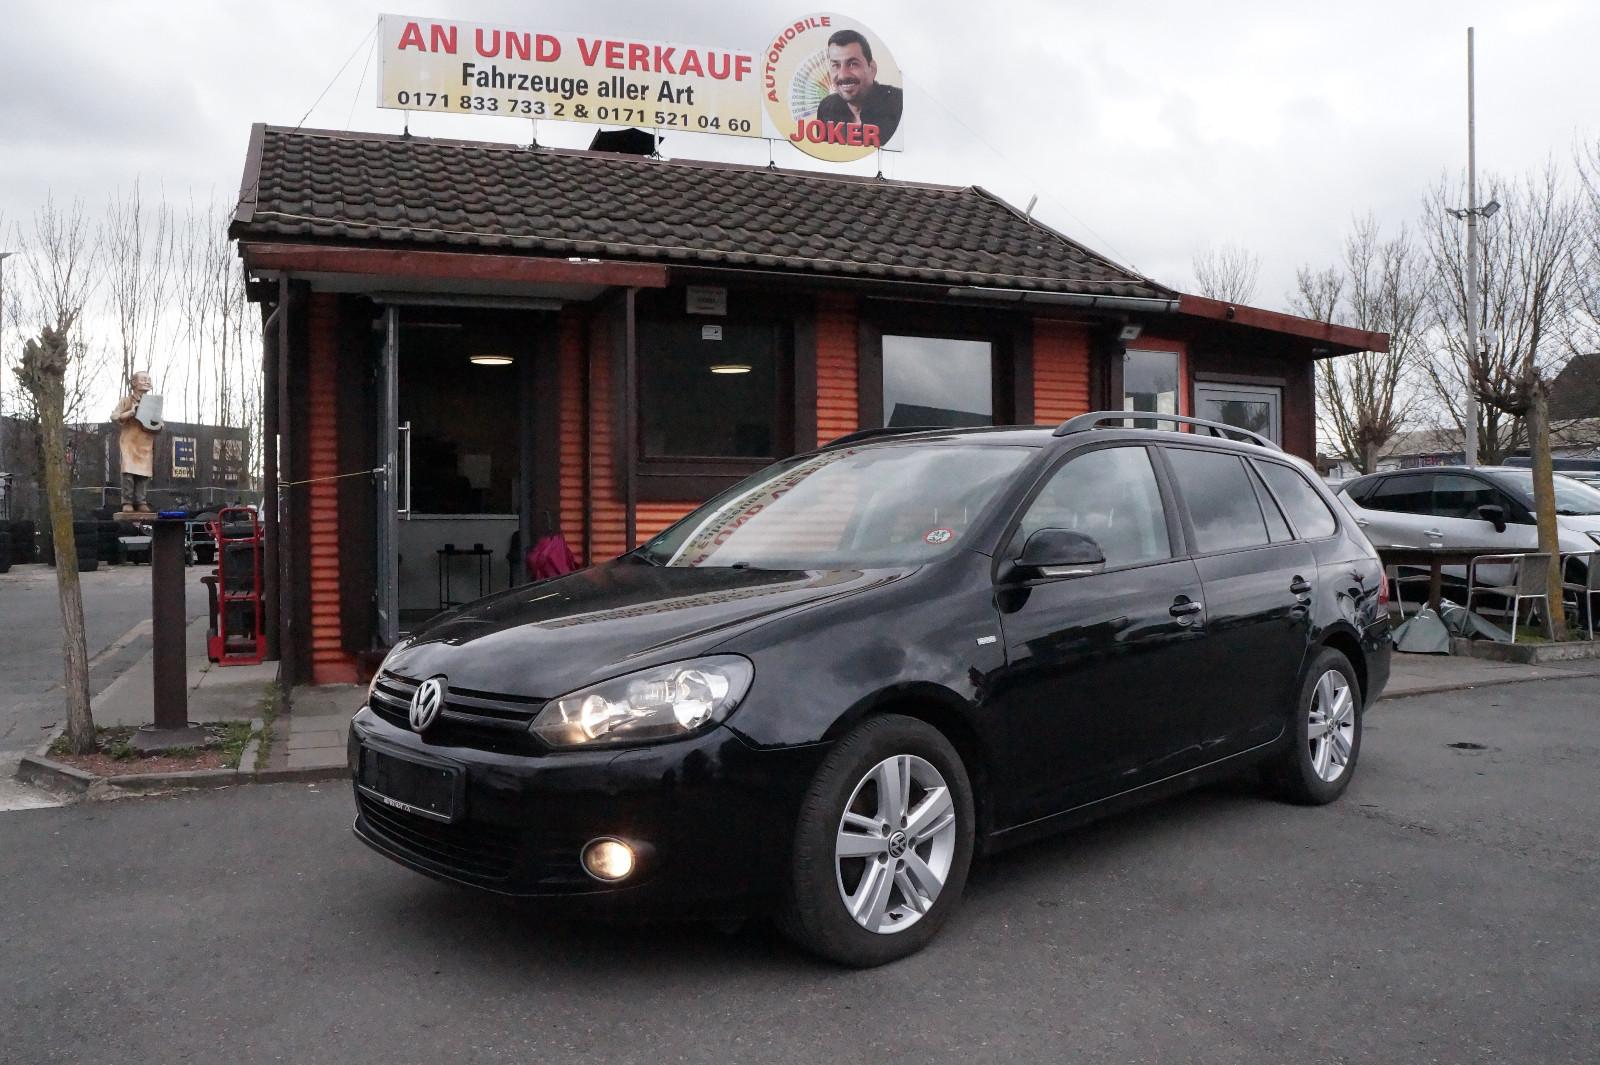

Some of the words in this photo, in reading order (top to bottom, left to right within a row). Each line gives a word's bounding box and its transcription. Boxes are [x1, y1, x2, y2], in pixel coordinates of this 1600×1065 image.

[397, 22, 458, 54] AN
[475, 28, 562, 62] UND
[576, 38, 752, 81] VERKAUF
[765, 16, 831, 103] AUTOMOBILE
[462, 62, 588, 100] Fahrzeuge
[597, 76, 649, 101] aller
[657, 80, 694, 106] Art
[397, 91, 449, 107] 0171
[459, 95, 498, 111] 833
[507, 99, 545, 115] 733
[554, 102, 565, 116] 2
[574, 104, 589, 119] &
[597, 106, 645, 123] 0171
[654, 111, 688, 126] 521
[698, 115, 720, 130] 04
[728, 118, 751, 132] 60
[789, 119, 880, 148] JOKER
[410, 679, 442, 731] VW
